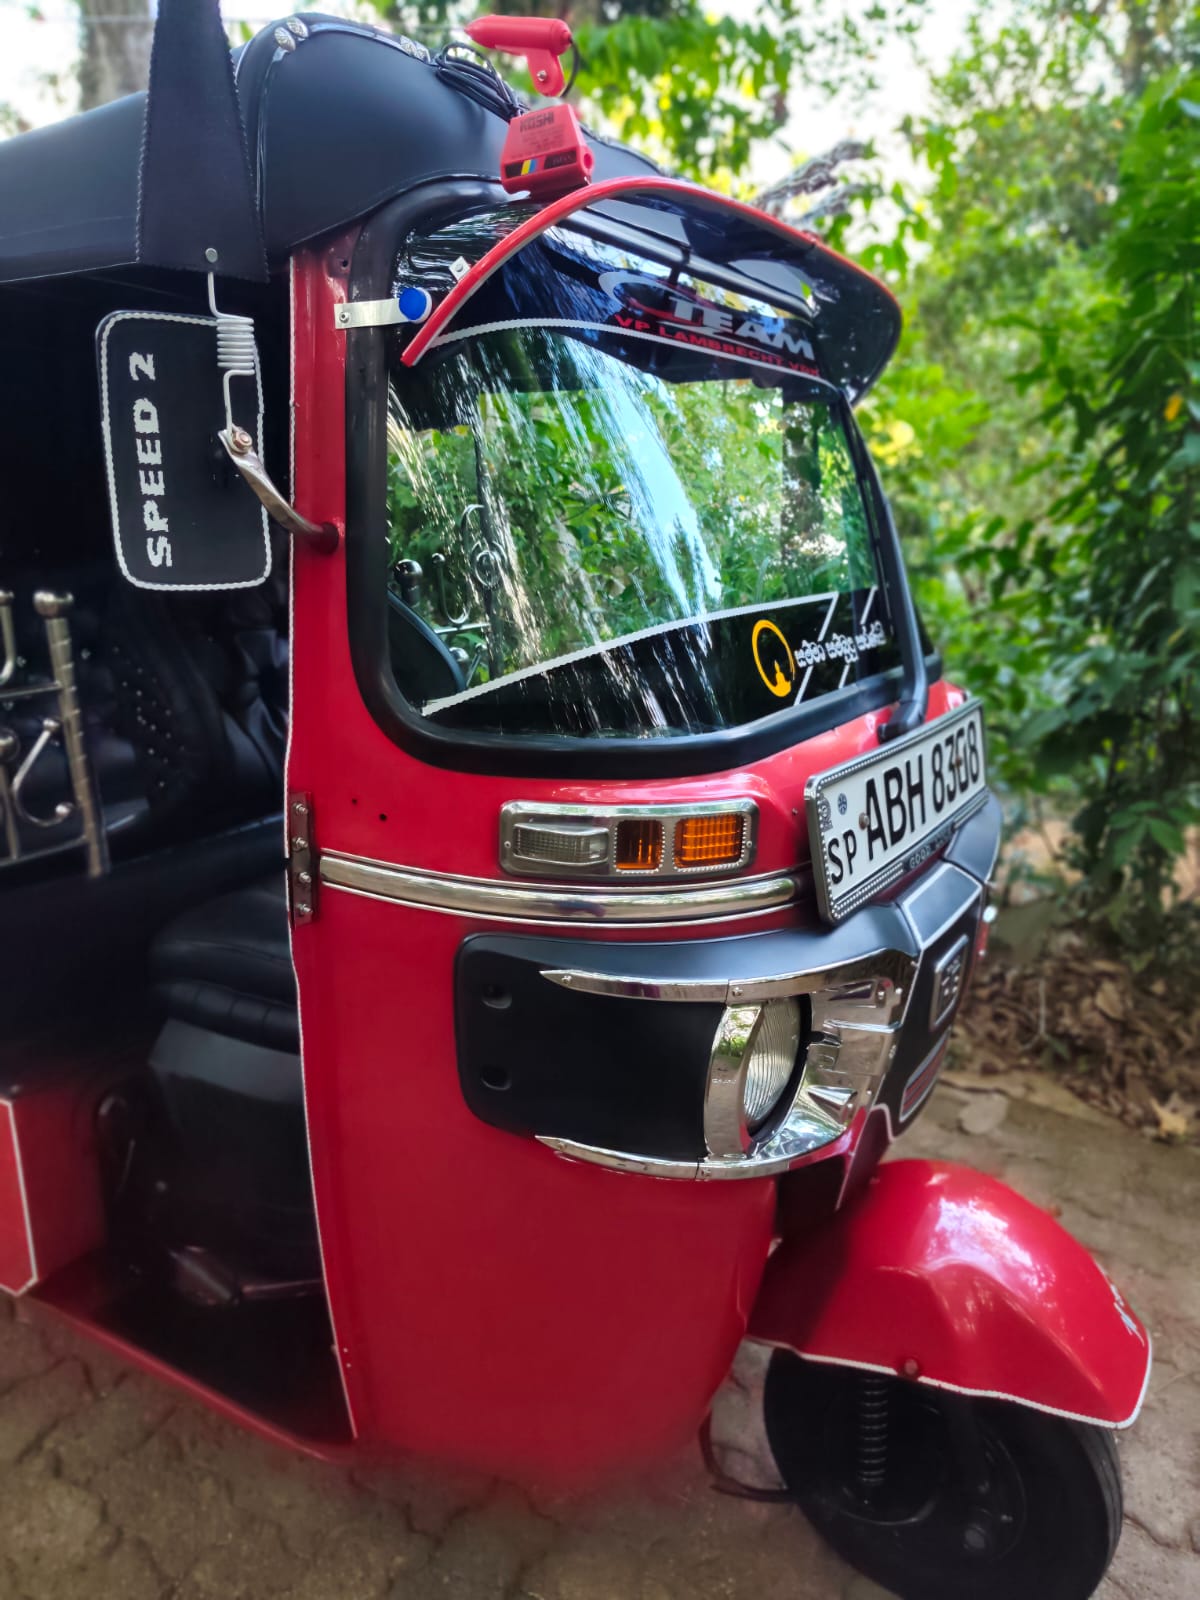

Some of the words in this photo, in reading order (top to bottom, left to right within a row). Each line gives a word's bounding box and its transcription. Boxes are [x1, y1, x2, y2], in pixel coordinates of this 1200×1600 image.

[614, 313, 650, 331] VP
[658, 325, 784, 366] LAMBRECHT
[668, 296, 815, 361] TEAM
[128, 351, 156, 381] 2
[133, 398, 172, 567] SPEED
[827, 828, 858, 885] SP
[865, 753, 926, 861] ABH
